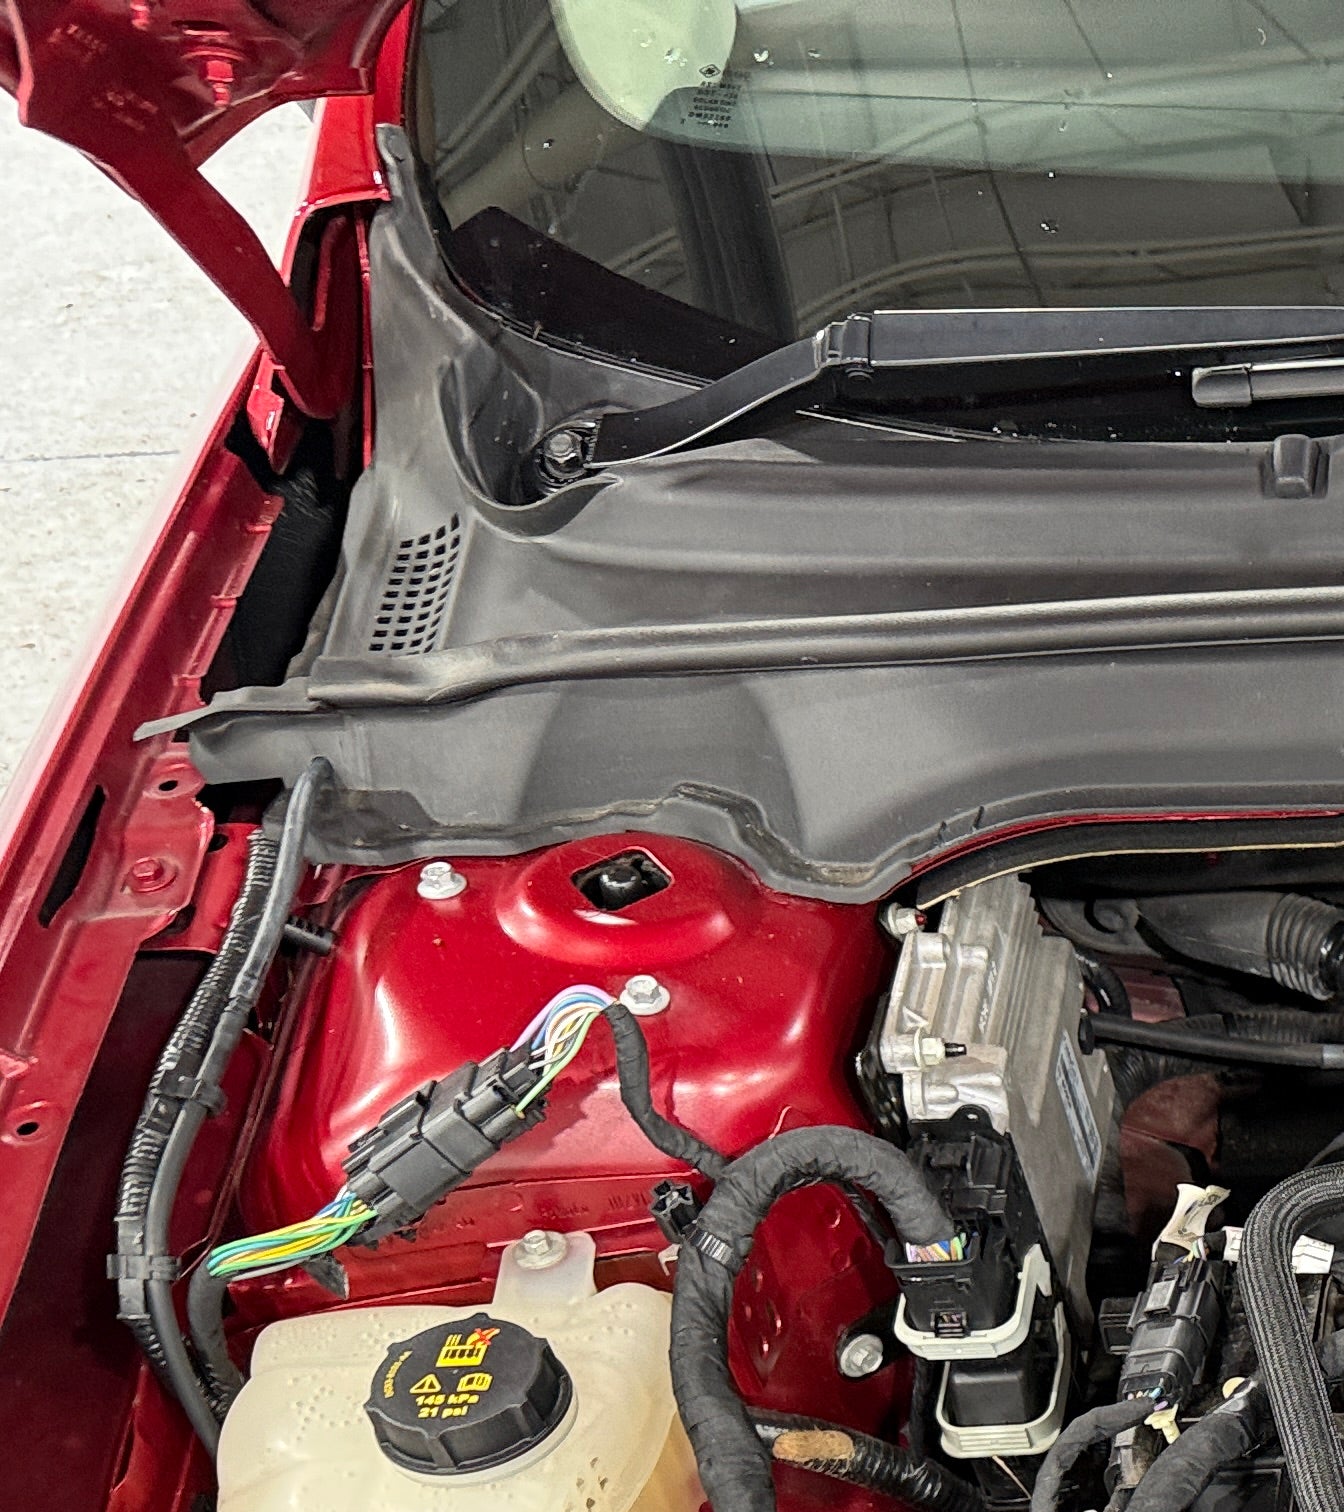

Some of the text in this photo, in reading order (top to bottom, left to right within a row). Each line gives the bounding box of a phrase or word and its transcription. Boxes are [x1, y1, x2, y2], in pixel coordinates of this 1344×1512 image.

[415, 1393, 480, 1406] 145 kPa
[417, 1405, 469, 1419] 21 psi
